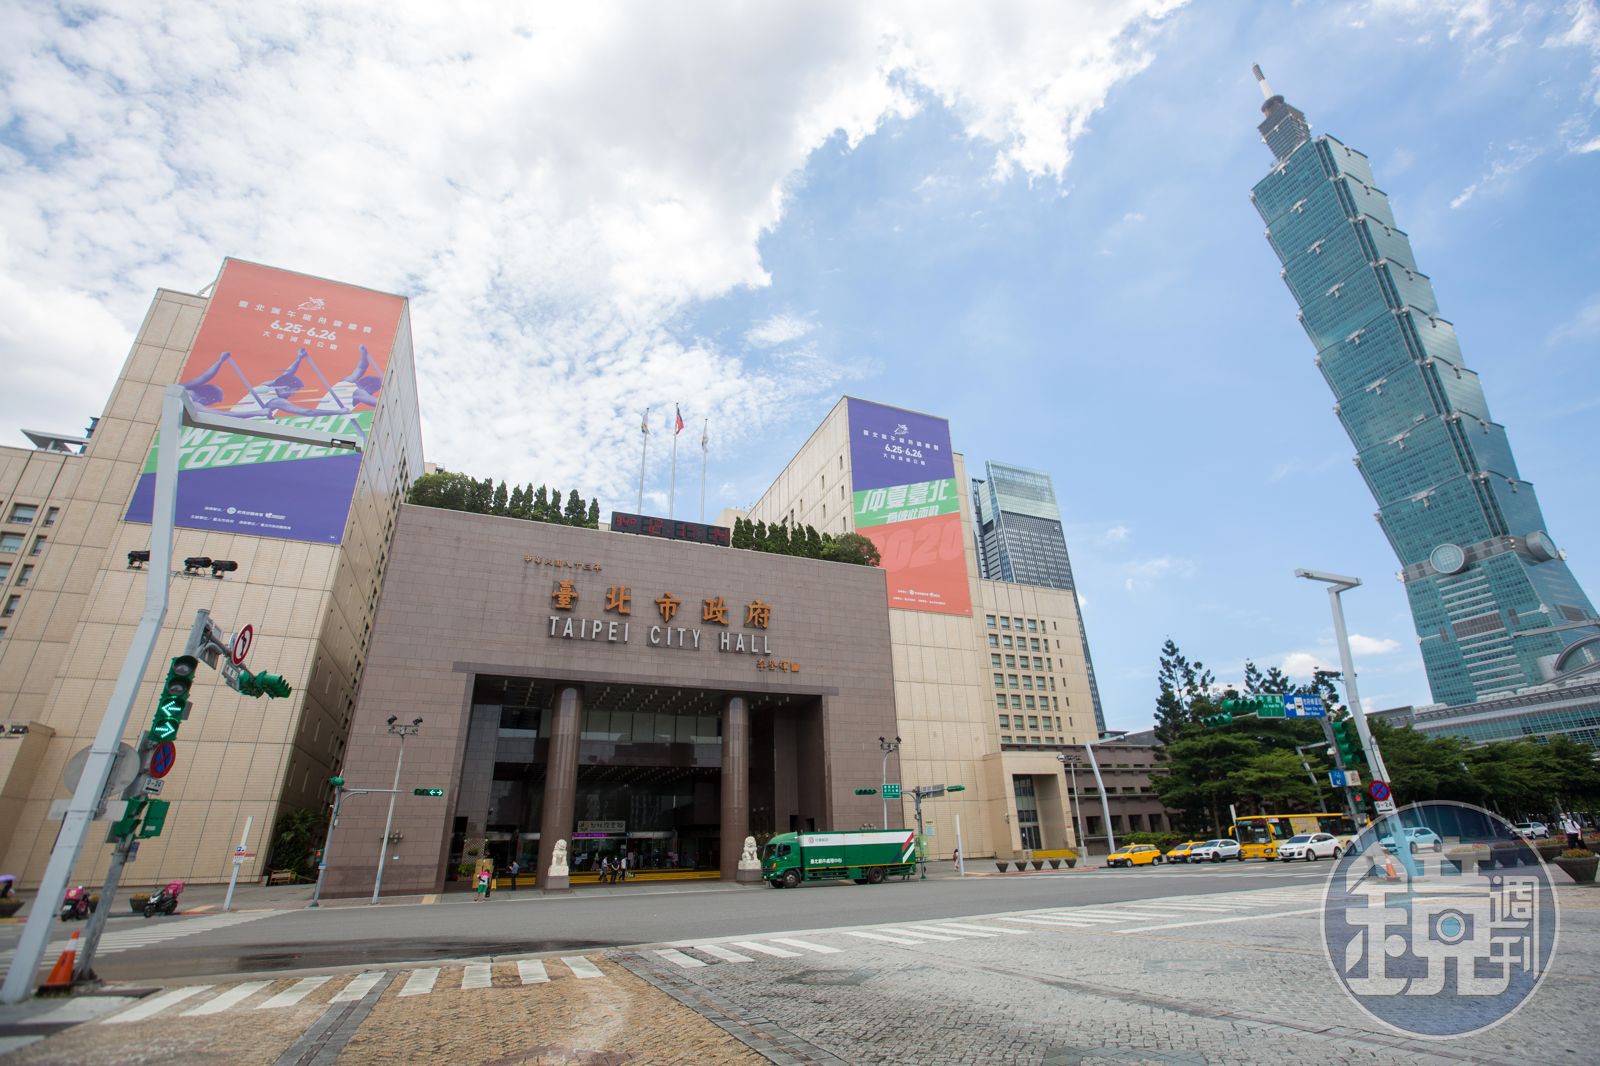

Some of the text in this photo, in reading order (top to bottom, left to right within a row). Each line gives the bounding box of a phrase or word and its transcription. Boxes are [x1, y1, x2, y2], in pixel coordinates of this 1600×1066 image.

[270, 320, 337, 340] 6.25-6.26
[884, 443, 922, 458] 6.25-6.26
[551, 580, 771, 630] 臺北市政府
[549, 615, 772, 655] TAIPEI CITY HALL
